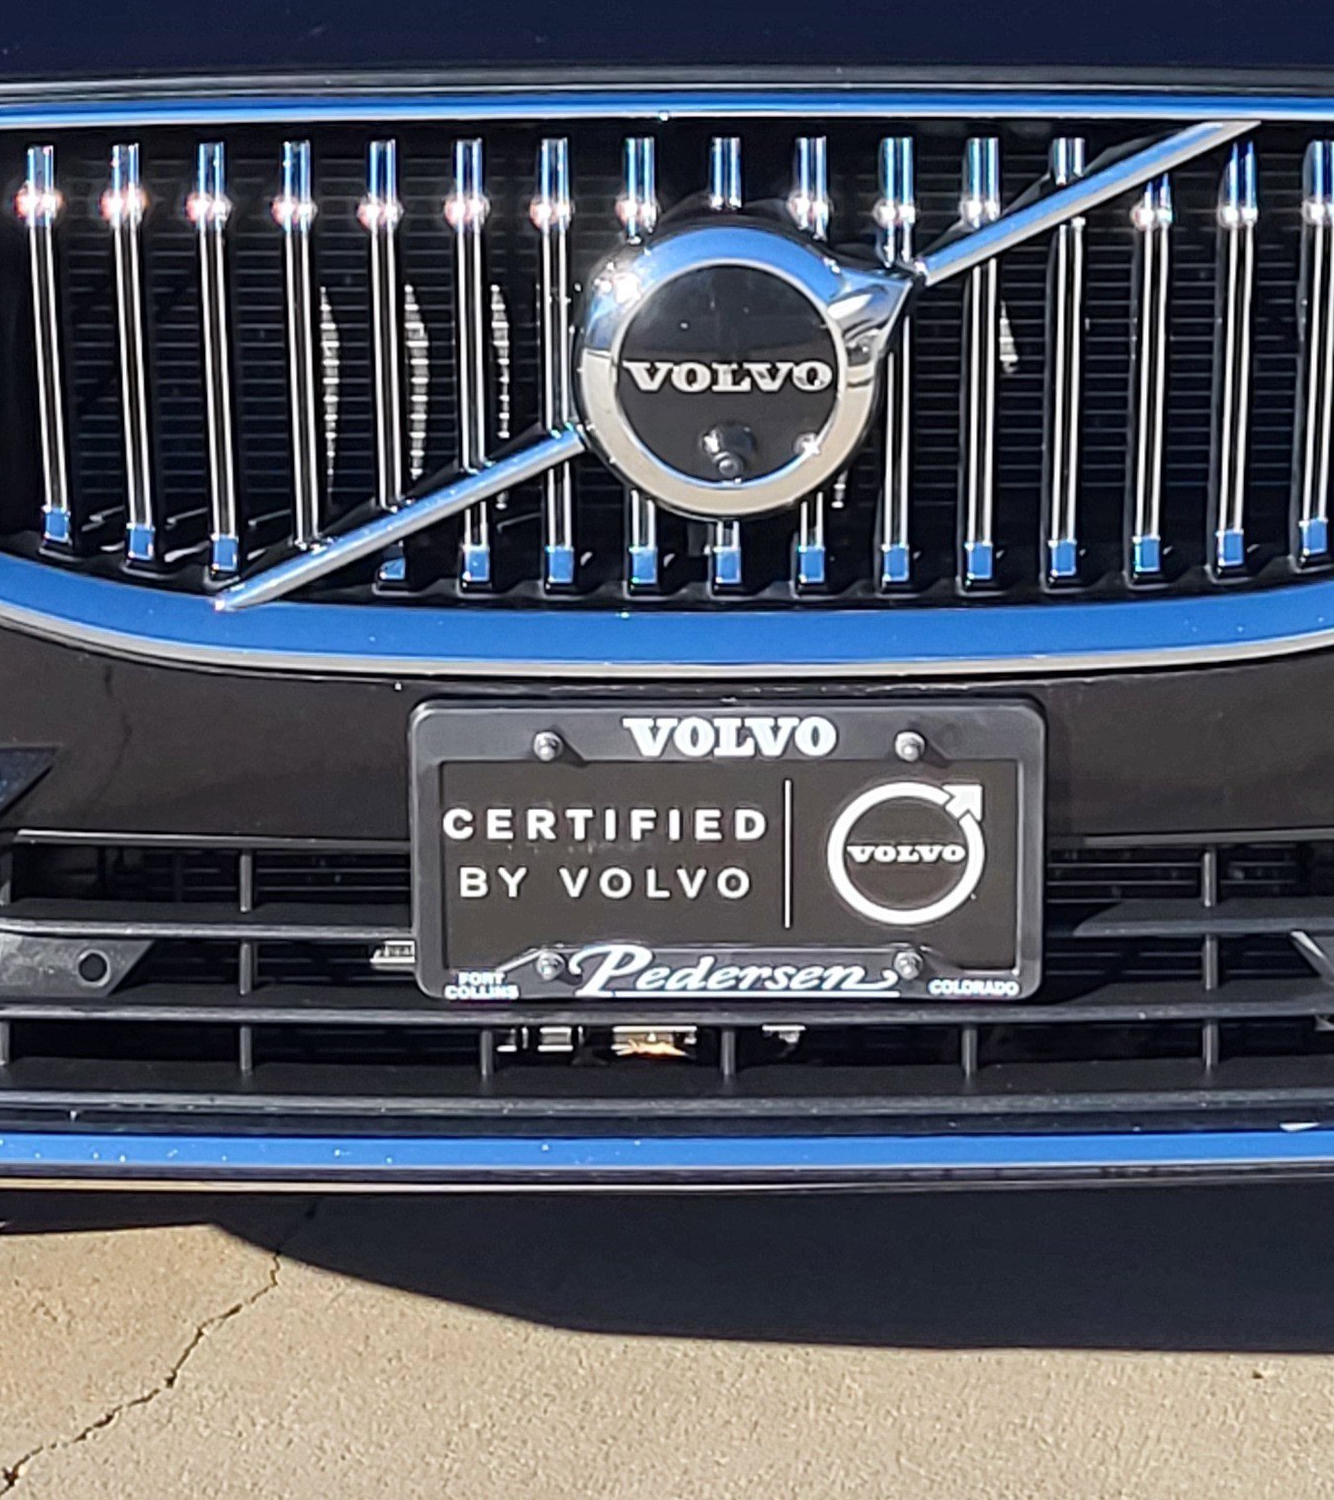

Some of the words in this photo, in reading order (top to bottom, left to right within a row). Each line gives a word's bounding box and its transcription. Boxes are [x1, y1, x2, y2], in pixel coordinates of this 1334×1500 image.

[622, 360, 834, 393] VOLVO
[623, 716, 837, 757] VOLVO
[442, 807, 766, 841] CERTIFIED
[846, 844, 966, 863] VOLVO
[460, 866, 528, 899] BY
[559, 866, 751, 899] VOLVO
[458, 971, 505, 985] FORT
[567, 943, 901, 998] Pedersen
[444, 984, 519, 1000] COLLINS
[927, 978, 1021, 997] COLORADO
